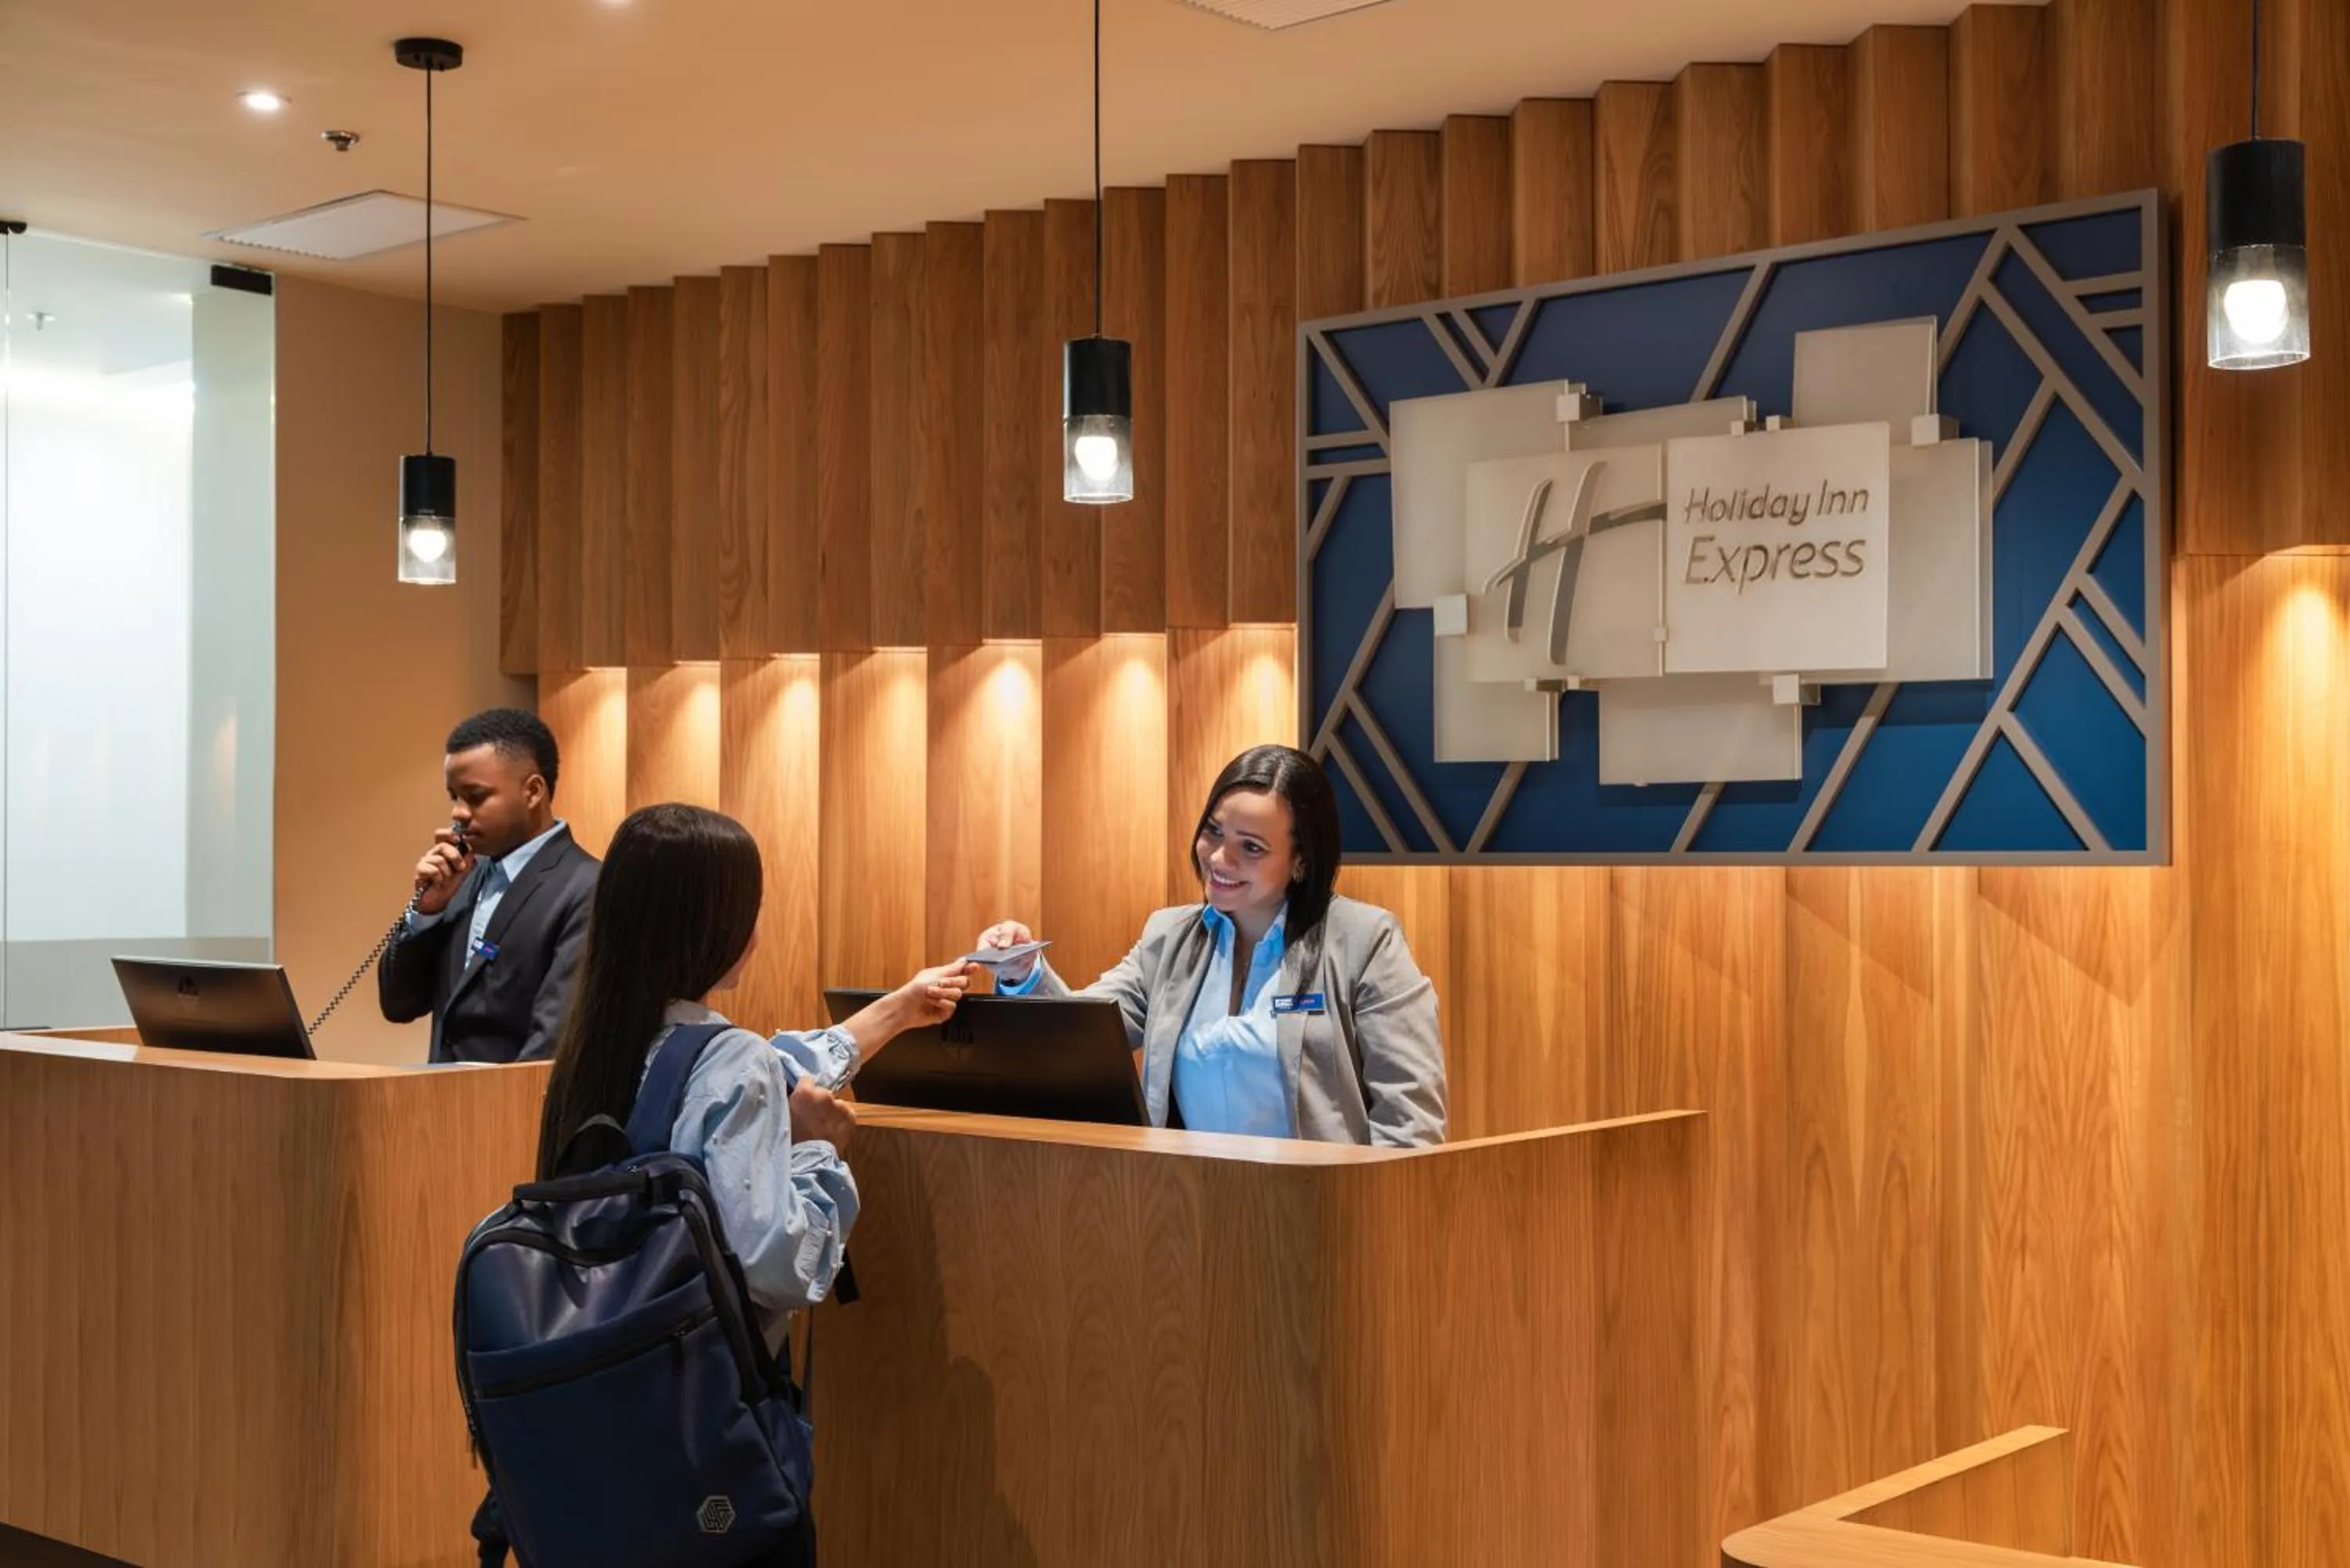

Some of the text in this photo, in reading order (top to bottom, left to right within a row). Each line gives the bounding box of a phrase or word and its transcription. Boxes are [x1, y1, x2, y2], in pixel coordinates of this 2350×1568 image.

[1684, 479, 1869, 526] Holiday Inn
[1685, 536, 1866, 594] Express
